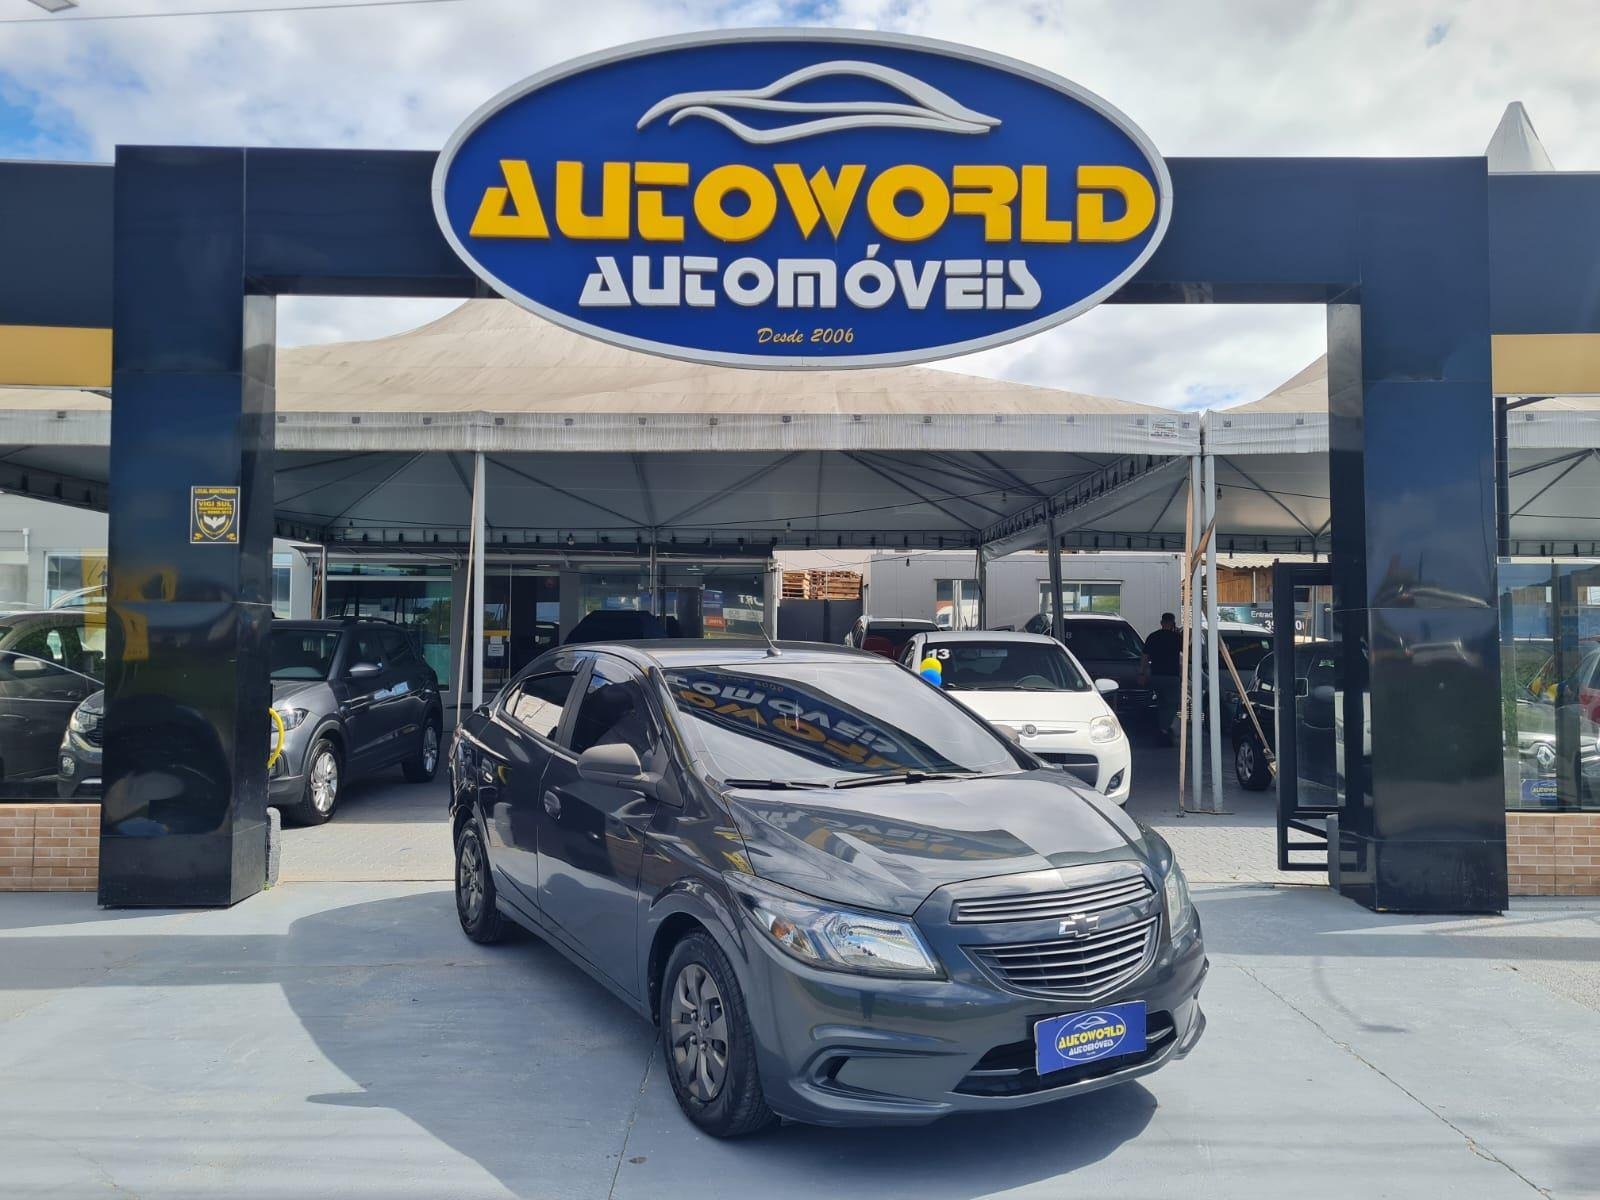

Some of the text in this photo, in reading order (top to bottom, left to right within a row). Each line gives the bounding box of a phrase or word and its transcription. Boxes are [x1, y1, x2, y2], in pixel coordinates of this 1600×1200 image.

[469, 158, 1157, 243] AUTOWORLD
[578, 244, 1042, 310] AUTOMÓVEIS
[757, 327, 854, 343] Desde 2006
[1251, 611, 1274, 619] Entrad
[928, 648, 951, 660] 13
[1058, 1024, 1124, 1050] AUTOWORLD
